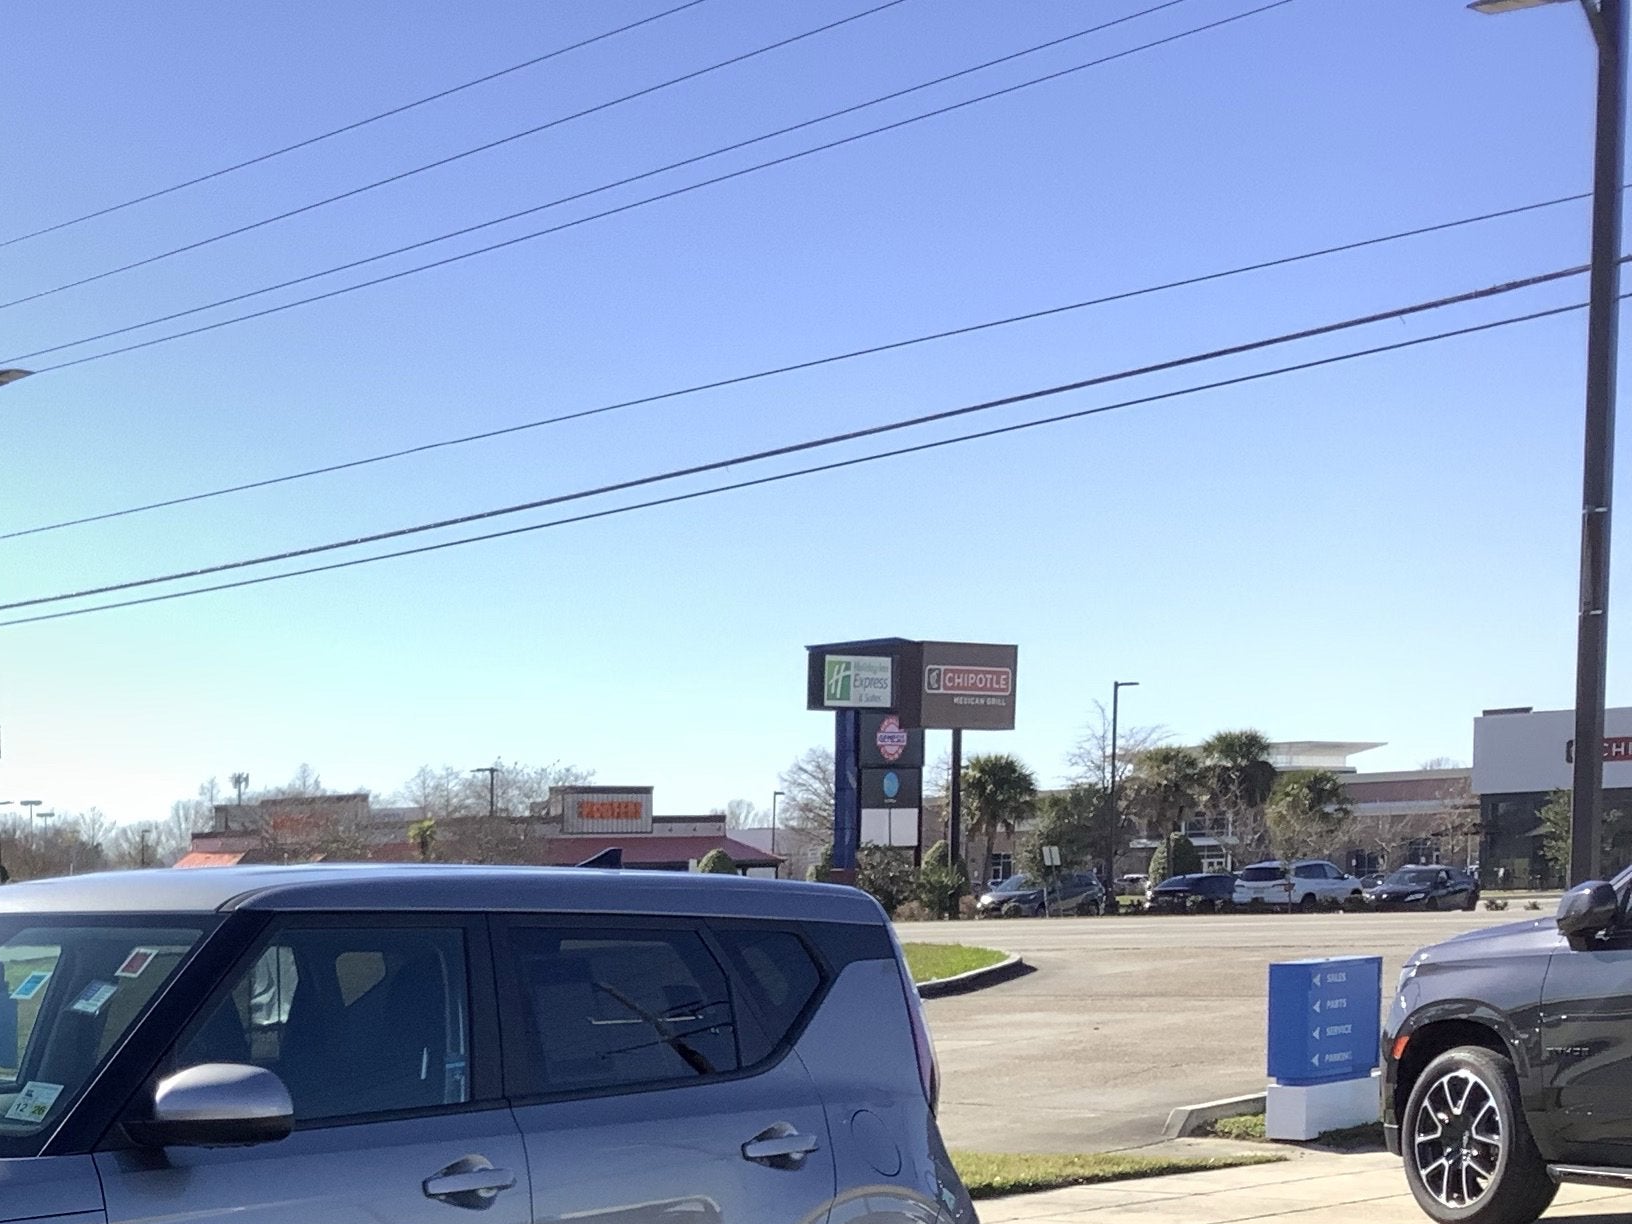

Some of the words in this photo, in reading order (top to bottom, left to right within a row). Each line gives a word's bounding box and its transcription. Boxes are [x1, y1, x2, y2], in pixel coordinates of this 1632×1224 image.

[945, 672, 1009, 689] CHIPOTLE
[953, 696, 985, 705] MEXICAN
[1327, 972, 1346, 983] SALES
[1326, 998, 1347, 1009] PARTS
[1326, 1024, 1352, 1036] SERVICE
[16, 1103, 28, 1113] 12
